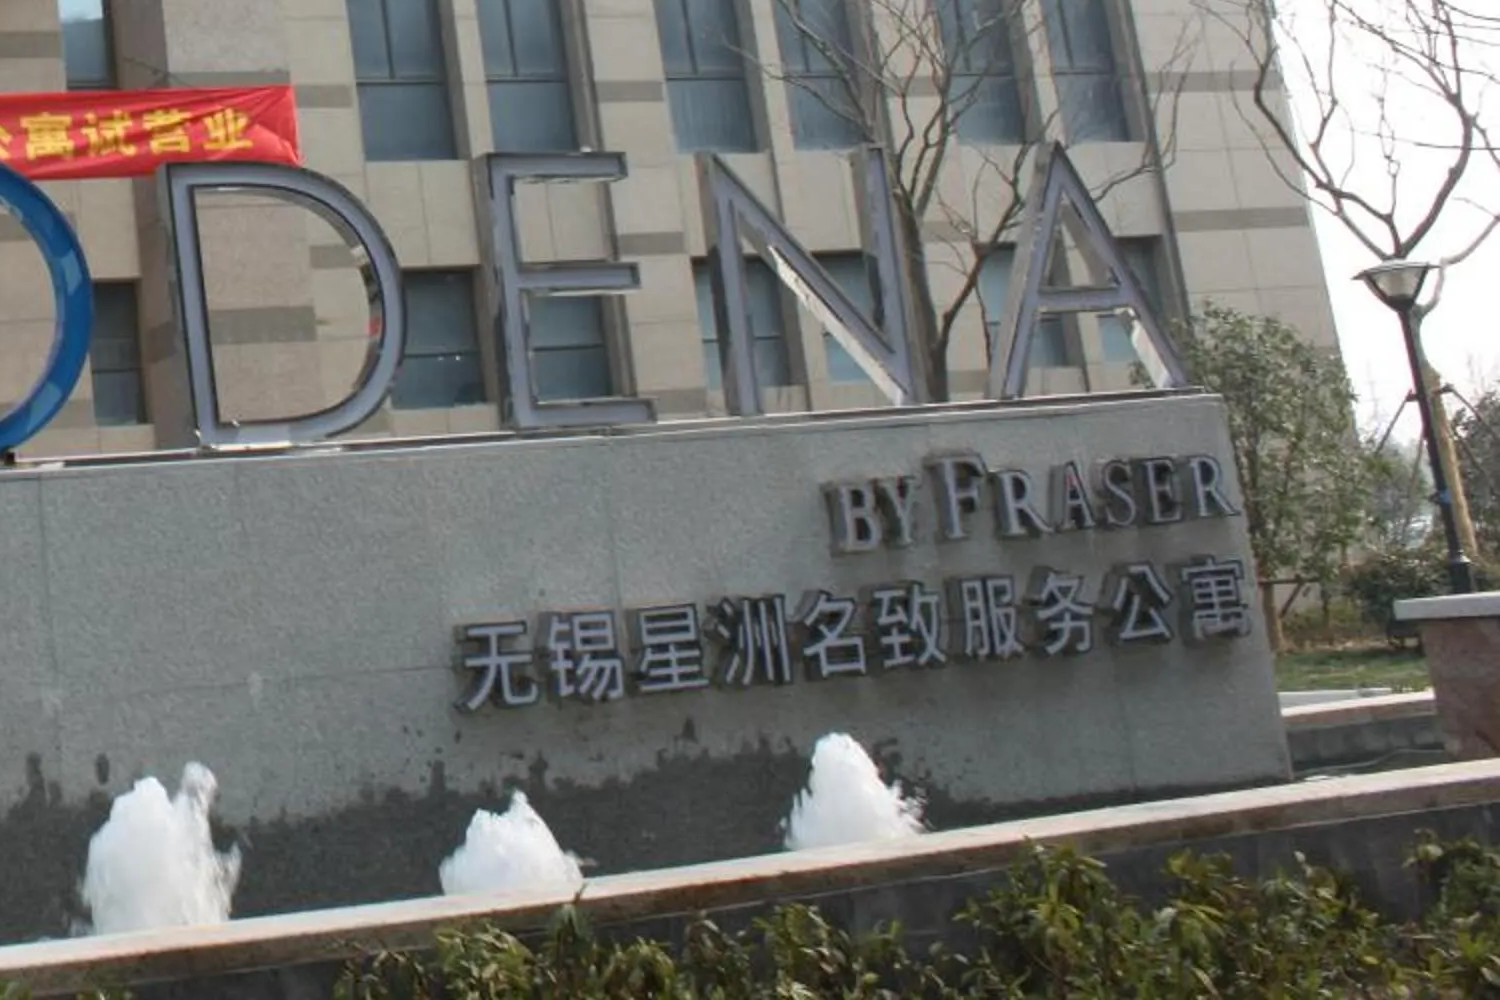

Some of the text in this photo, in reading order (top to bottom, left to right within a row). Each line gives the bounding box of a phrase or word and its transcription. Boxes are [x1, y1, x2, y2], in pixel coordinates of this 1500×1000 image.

[824, 454, 1238, 553] BY FRASER
[455, 556, 1252, 712] 无锡星洲名致服务公寓
